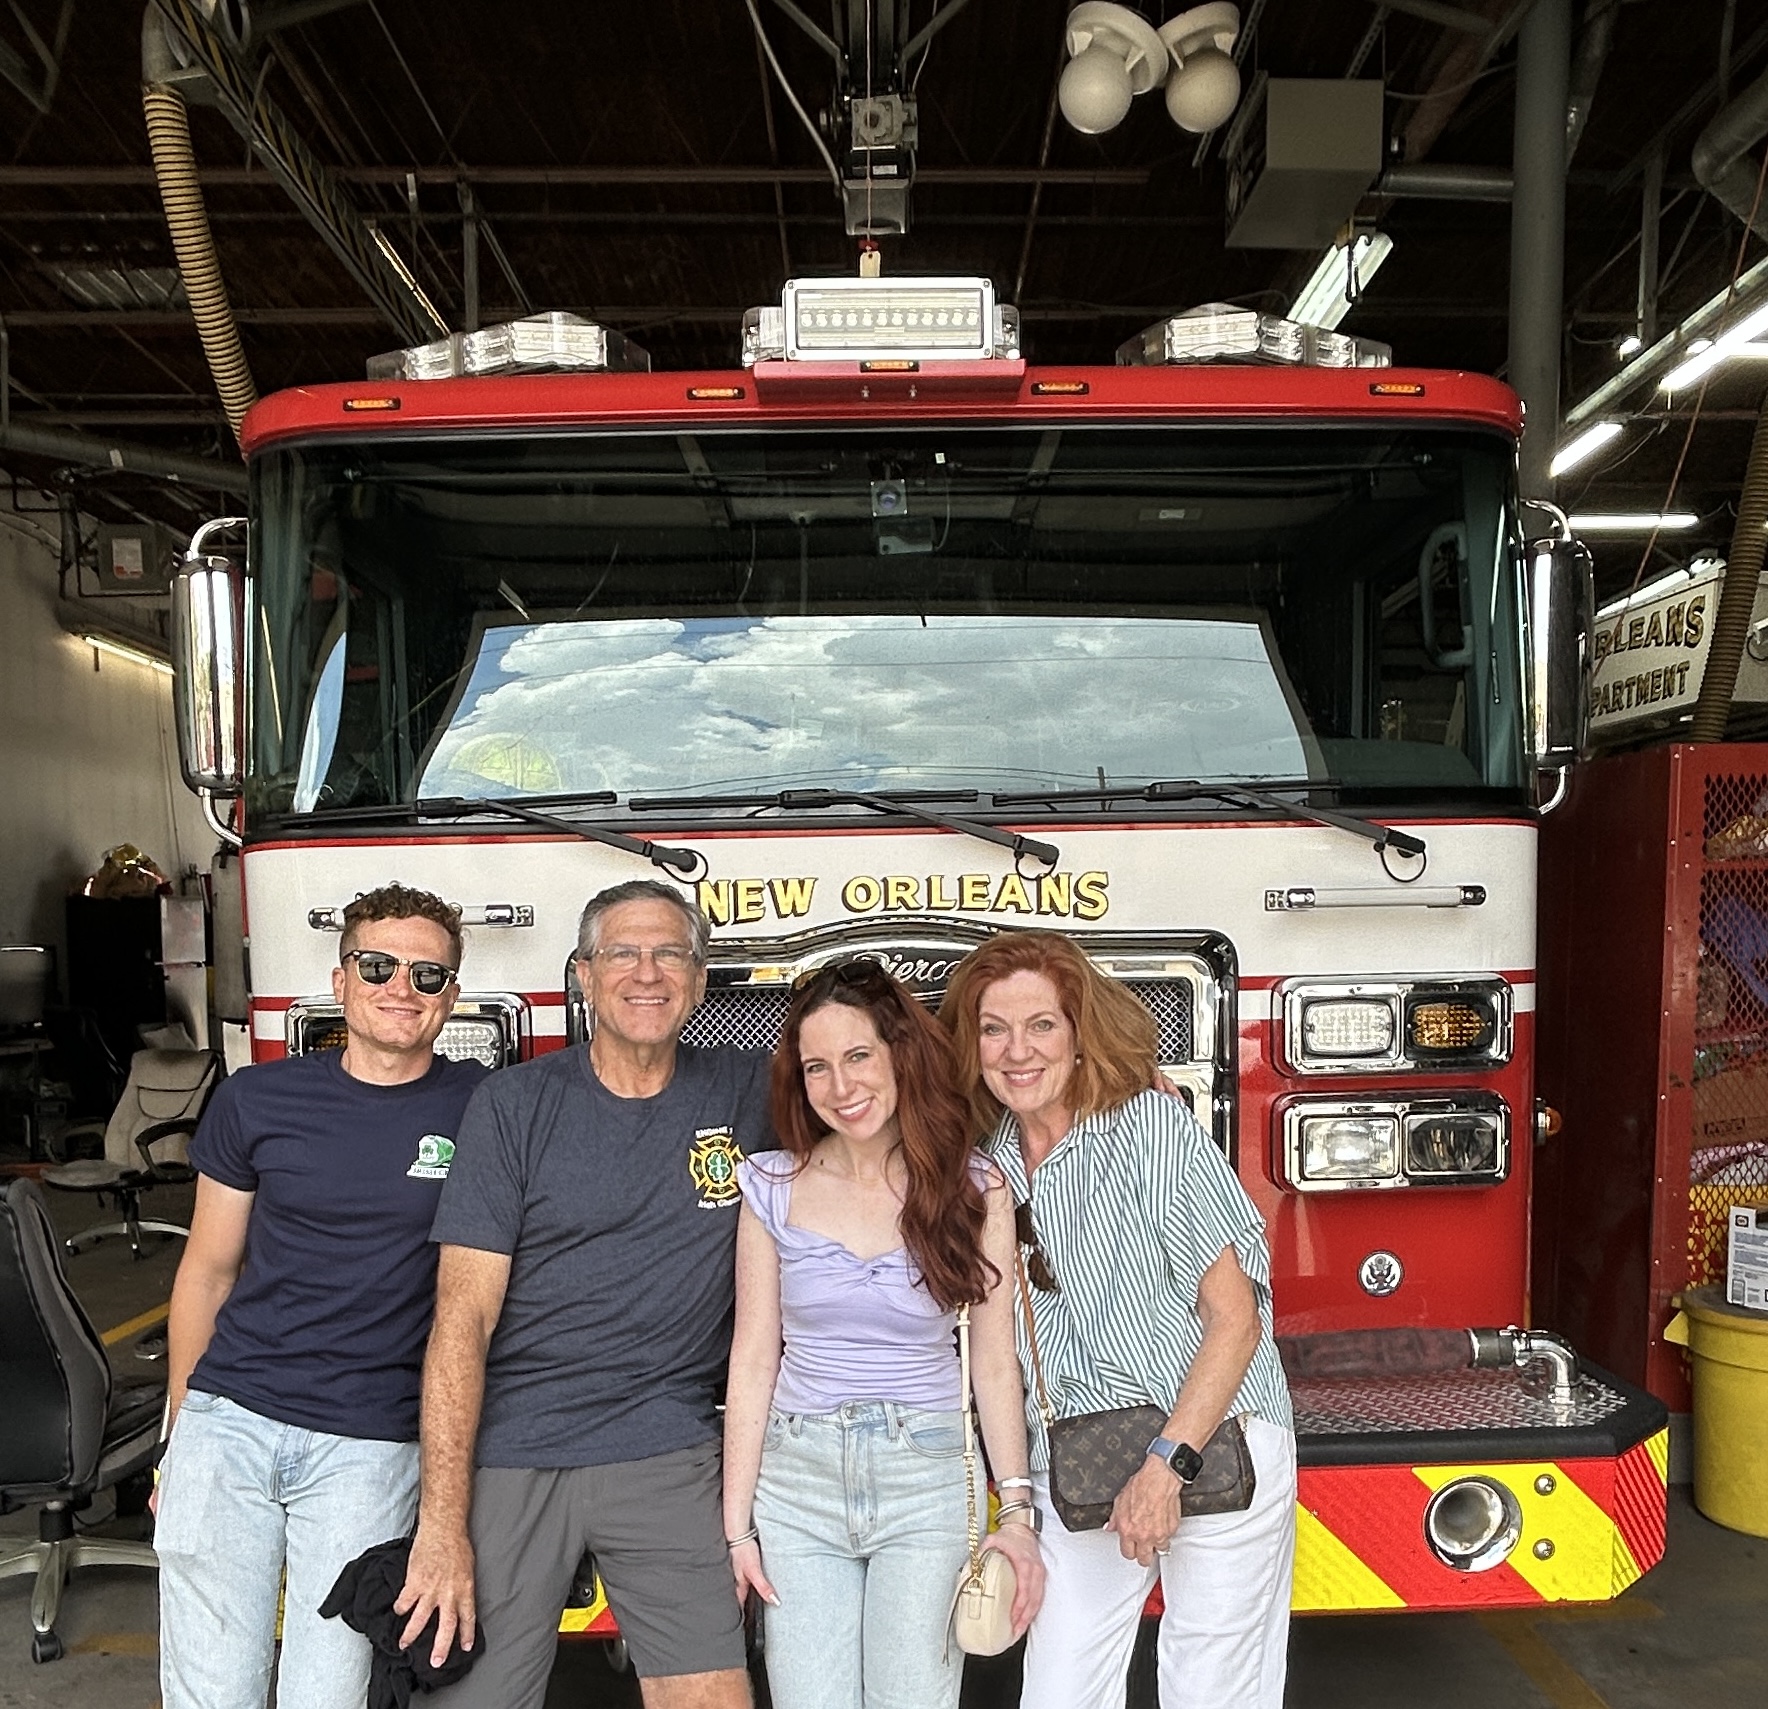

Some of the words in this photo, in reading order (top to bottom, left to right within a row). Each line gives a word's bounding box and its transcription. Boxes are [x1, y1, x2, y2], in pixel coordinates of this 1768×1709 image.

[1595, 595, 1706, 660] RLEANS
[694, 878, 818, 926] NEW
[841, 870, 1109, 921] ORLEANS
